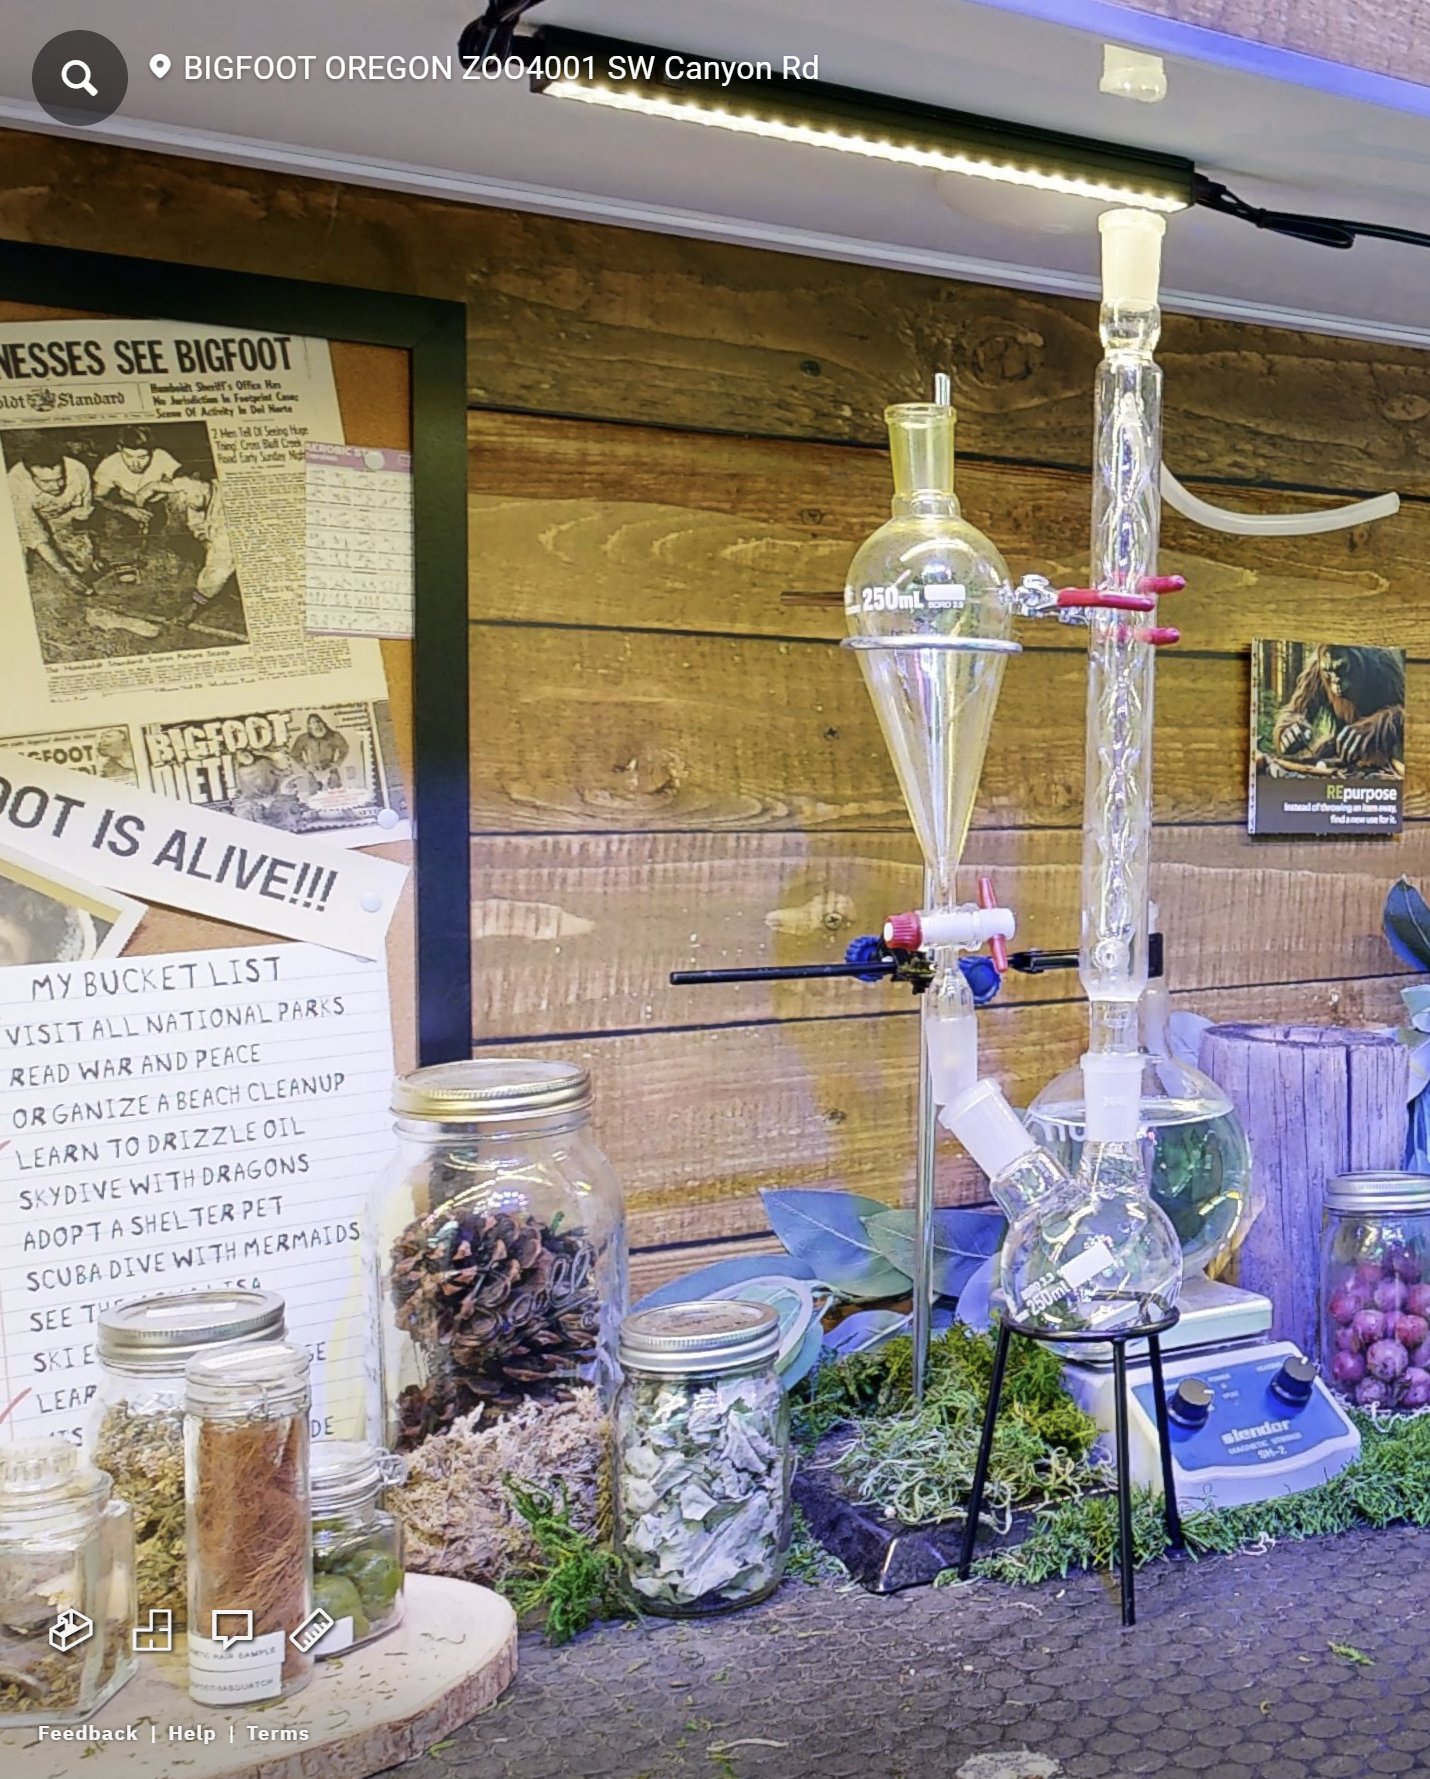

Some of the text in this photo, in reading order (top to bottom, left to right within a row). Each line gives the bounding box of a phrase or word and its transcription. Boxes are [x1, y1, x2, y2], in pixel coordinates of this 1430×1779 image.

[114, 340, 169, 375] SEE
[174, 337, 291, 374] BIGFOOT
[57, 391, 126, 408] Standard
[862, 586, 925, 612] 250mL
[146, 713, 293, 767] BIGFOOT
[1284, 802, 1312, 812] Instead
[1312, 802, 1321, 811] of
[1320, 802, 1353, 814] throwing
[1362, 803, 1379, 812] item
[1327, 785, 1398, 803] REpurpose
[1330, 814, 1346, 824] find
[1350, 816, 1366, 824] new
[1366, 816, 1379, 824] use
[1379, 814, 1389, 824] for
[93, 809, 145, 857] IS
[153, 830, 339, 912] ALIVE!!!
[32, 956, 282, 1001] MY BUCKET LIST
[6, 996, 345, 1046] VISIT ALL NATIONAL PARKS
[10, 1043, 262, 1087] READ WAR AND PEACE
[12, 1072, 346, 1129] ORGANIZE A BEACH CLEANUP
[15, 1116, 306, 1170] LEARN TO DRIZZLE OIL
[20, 1153, 310, 1211] SKYDIVE WITH DRAGONS
[24, 1196, 284, 1251] ADOPT A SHELTER PET
[27, 1222, 361, 1292] SCUBA DIVE WITH MERMAIDS
[30, 1307, 73, 1332] SEE
[33, 1347, 75, 1373] SKI
